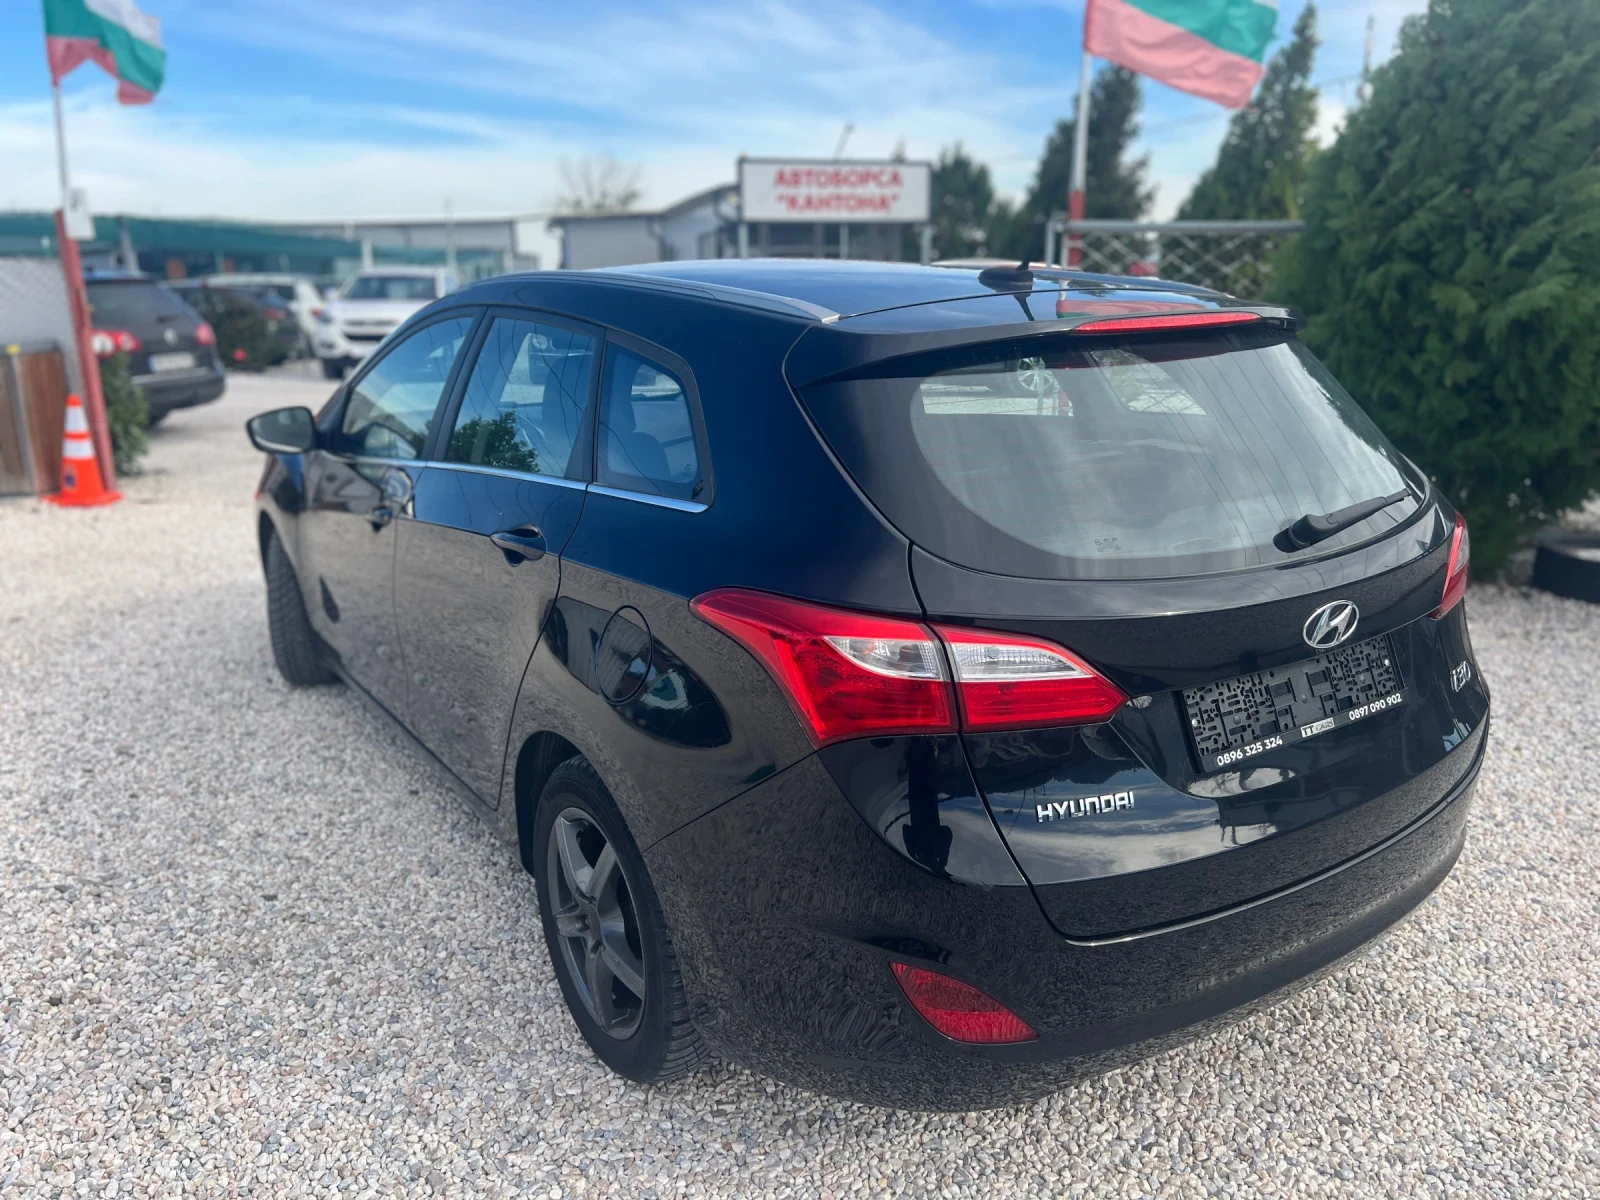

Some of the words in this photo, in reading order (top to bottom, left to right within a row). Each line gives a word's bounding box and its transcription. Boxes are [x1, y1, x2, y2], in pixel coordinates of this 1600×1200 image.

[774, 168, 904, 188] АВТОБОРСА
[1348, 705, 1368, 720] 0897
[1370, 699, 1386, 712] 090
[1386, 693, 1402, 706] 902
[1315, 718, 1334, 732] CARS
[1217, 748, 1243, 766] 0896
[1244, 742, 1263, 756] 325
[1264, 735, 1283, 749] 324
[1036, 791, 1135, 822] HYUNDAI
